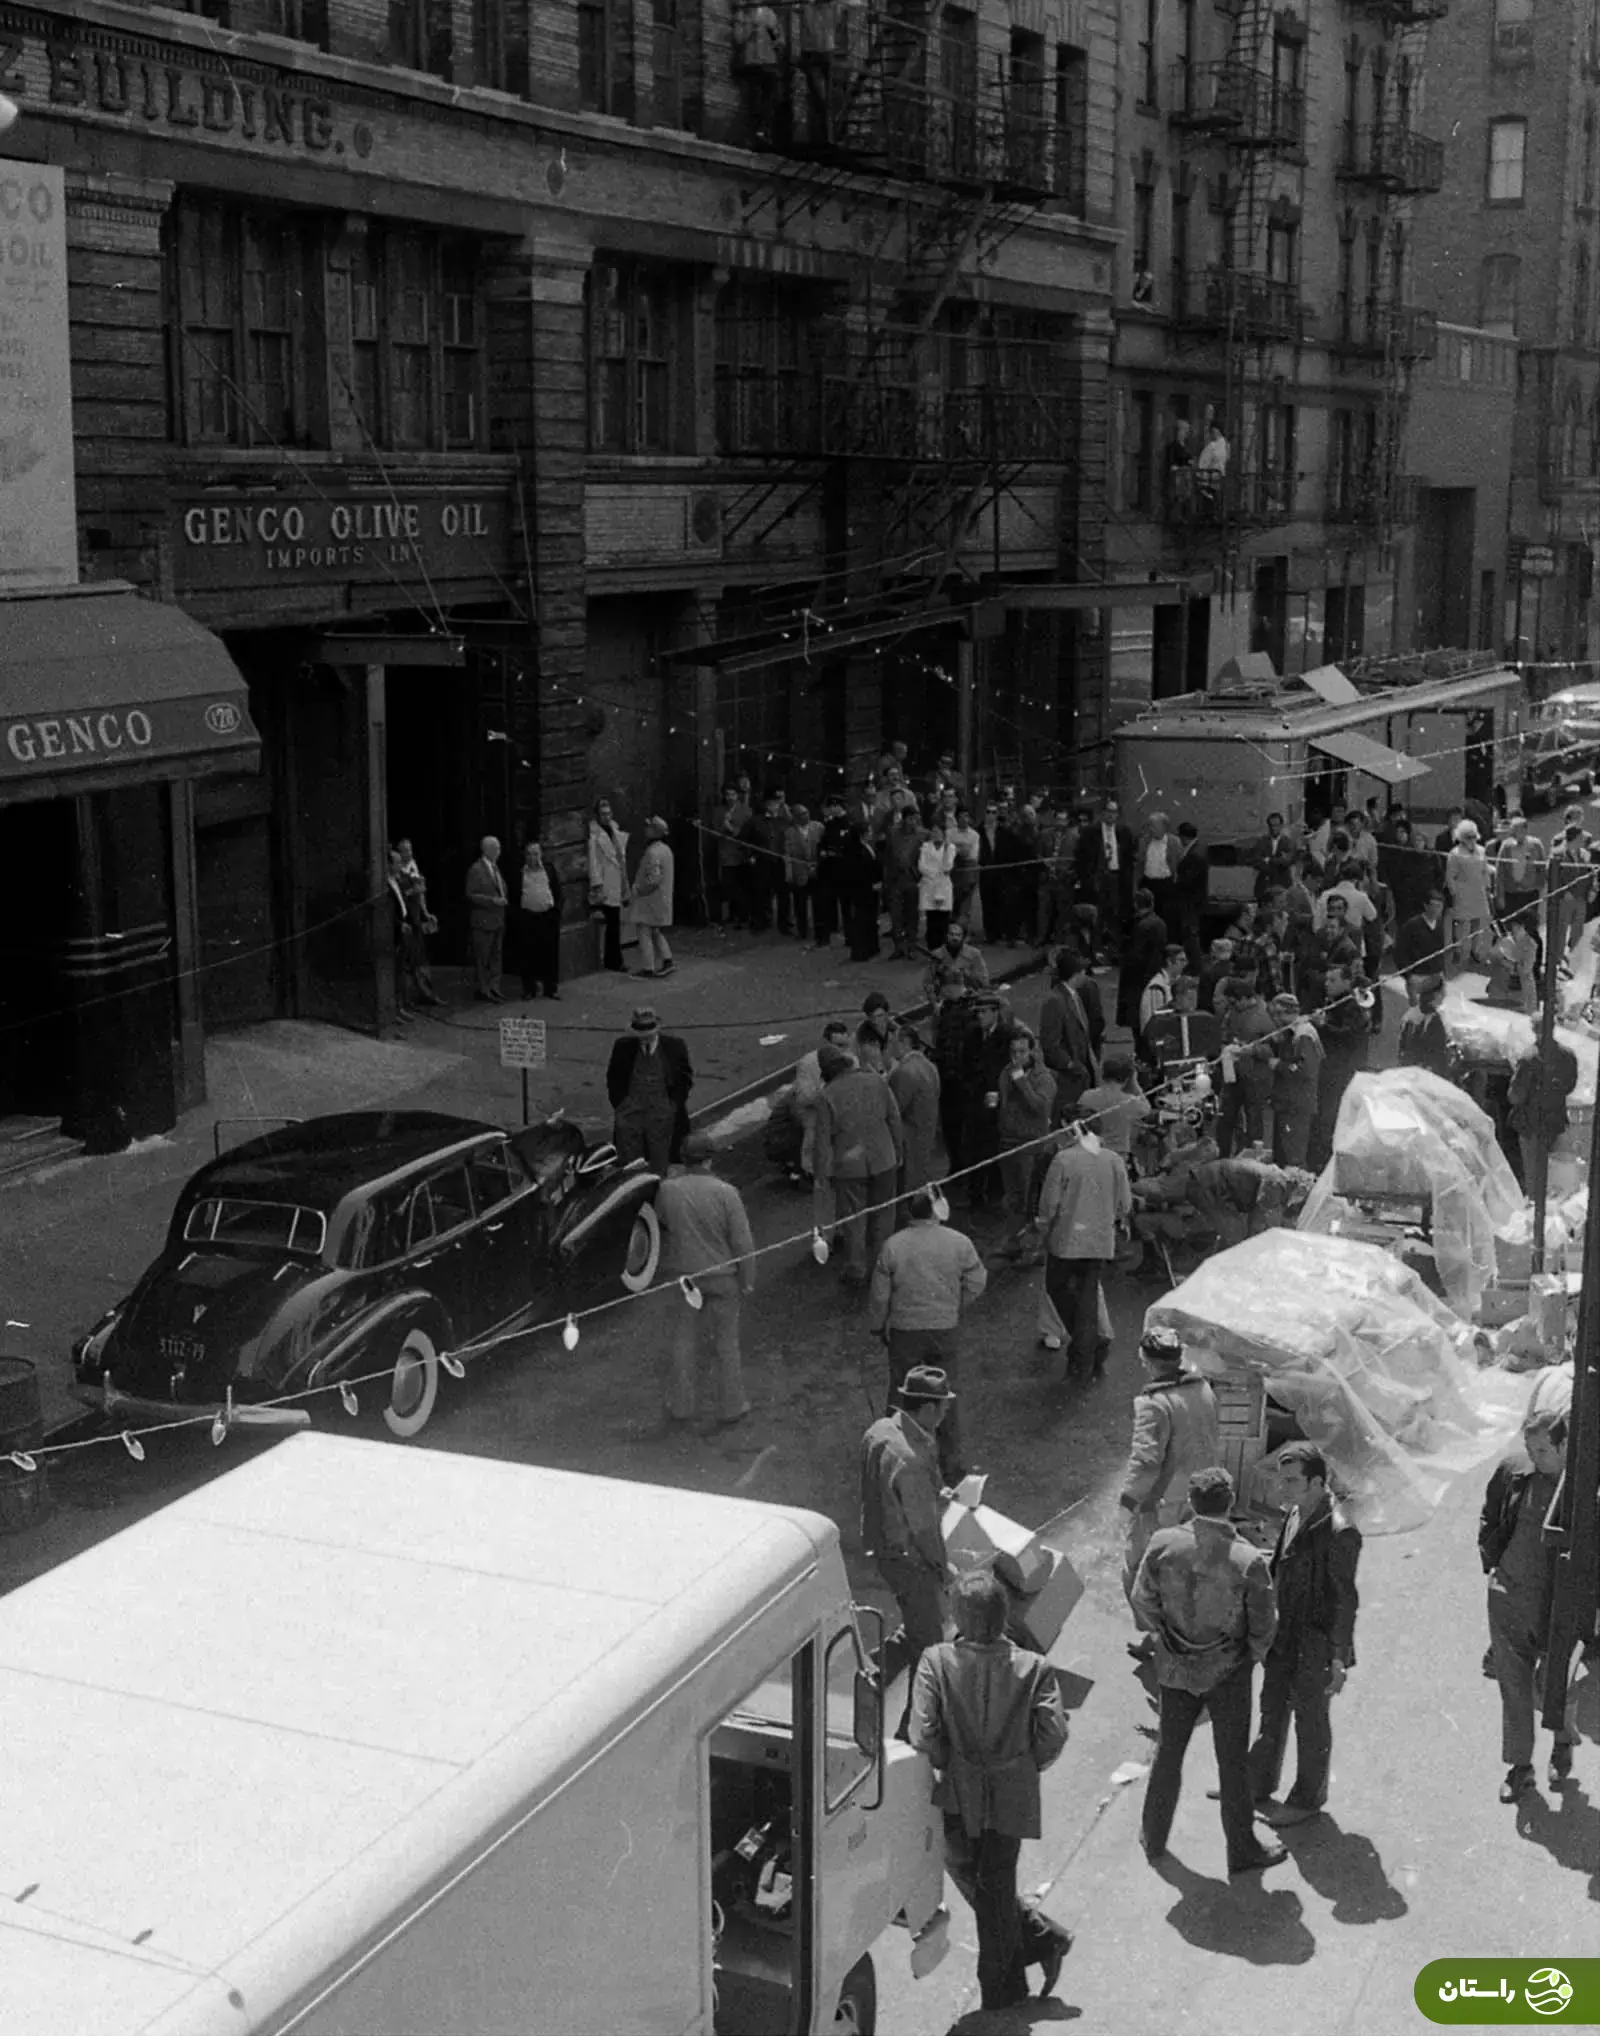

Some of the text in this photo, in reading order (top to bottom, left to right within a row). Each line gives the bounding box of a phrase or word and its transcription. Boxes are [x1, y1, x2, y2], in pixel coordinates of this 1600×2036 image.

[49, 47, 345, 155] BUILDING.
[185, 503, 488, 544] GENCO OLIVE OIL
[267, 546, 364, 569] IMPORTS
[8, 710, 152, 761] GENCO
